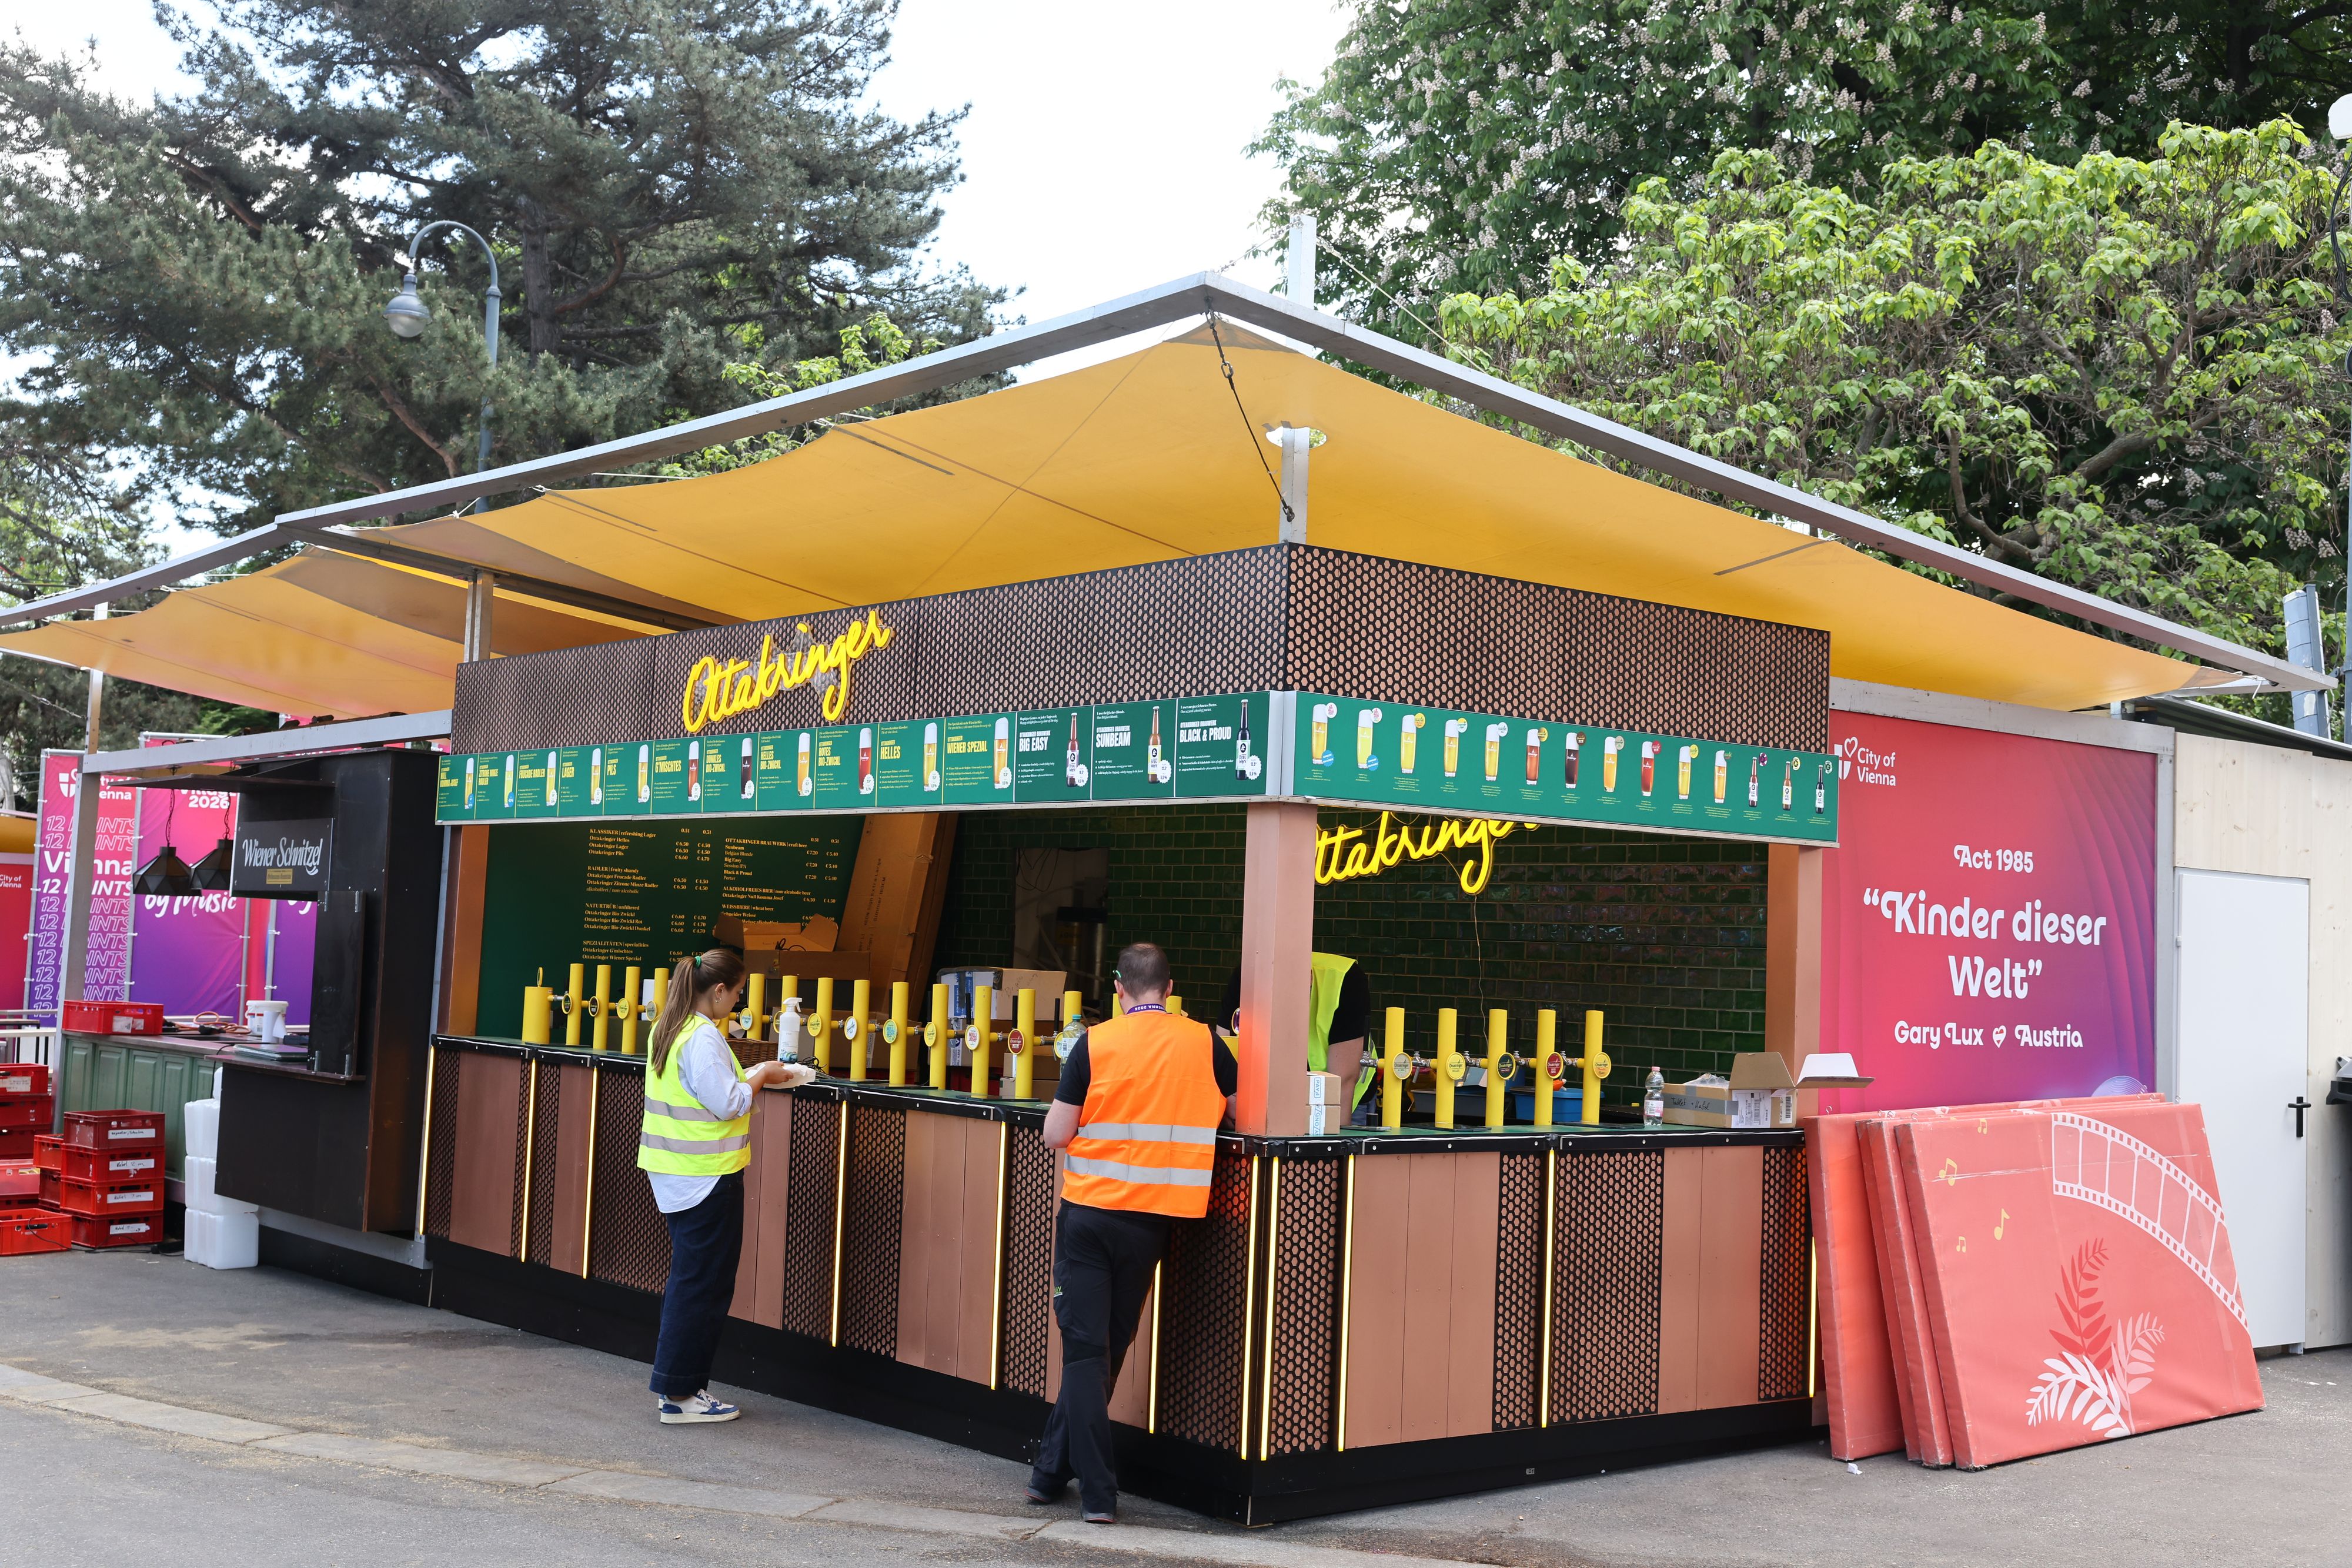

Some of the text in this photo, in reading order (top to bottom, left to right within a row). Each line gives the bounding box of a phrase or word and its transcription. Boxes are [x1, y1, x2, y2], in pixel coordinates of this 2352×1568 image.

[683, 610, 890, 733] Ottakringer
[1096, 731, 1131, 748] SUNBEAM
[1180, 727, 1231, 743] BLACK & PROUD
[819, 747, 830, 756] ROTES
[881, 746, 900, 760] HELLES
[947, 741, 987, 754] WIENER SPEZIAL
[1019, 737, 1048, 752] BIG EASY
[706, 754, 721, 763] DUNKLES
[761, 751, 773, 760] HELLES
[818, 756, 840, 766] BIO-ZWICKL
[1857, 747, 1895, 770] City of
[562, 767, 574, 778] LAGER
[607, 764, 616, 775] PILS
[706, 764, 725, 773] BIO-ZWICKL
[760, 760, 781, 770] BIO-ZWICKL
[1857, 766, 1896, 786] Vienna
[99, 791, 132, 800] enna
[189, 796, 229, 808] 2026
[46, 815, 135, 834] 12 INTS
[45, 833, 133, 851] 12 INTS
[242, 837, 323, 875] Wiener Schnitzel
[1315, 811, 1537, 893] ttakringe
[1954, 845, 2033, 873] Act 1985
[44, 851, 132, 875] Vinna
[42, 879, 132, 897] 12 INTS
[41, 897, 130, 914] 12 INTS
[173, 892, 236, 917] Music
[39, 914, 129, 932] 12 INTS
[2012, 900, 2106, 945] dieser
[38, 932, 128, 950] 12 INTS
[38, 949, 126, 967] 12 INTS
[36, 967, 126, 984] 12 INTS
[35, 984, 125, 1001] 12 INTS
[1895, 1021, 2083, 1049] Gary Lux Austria
